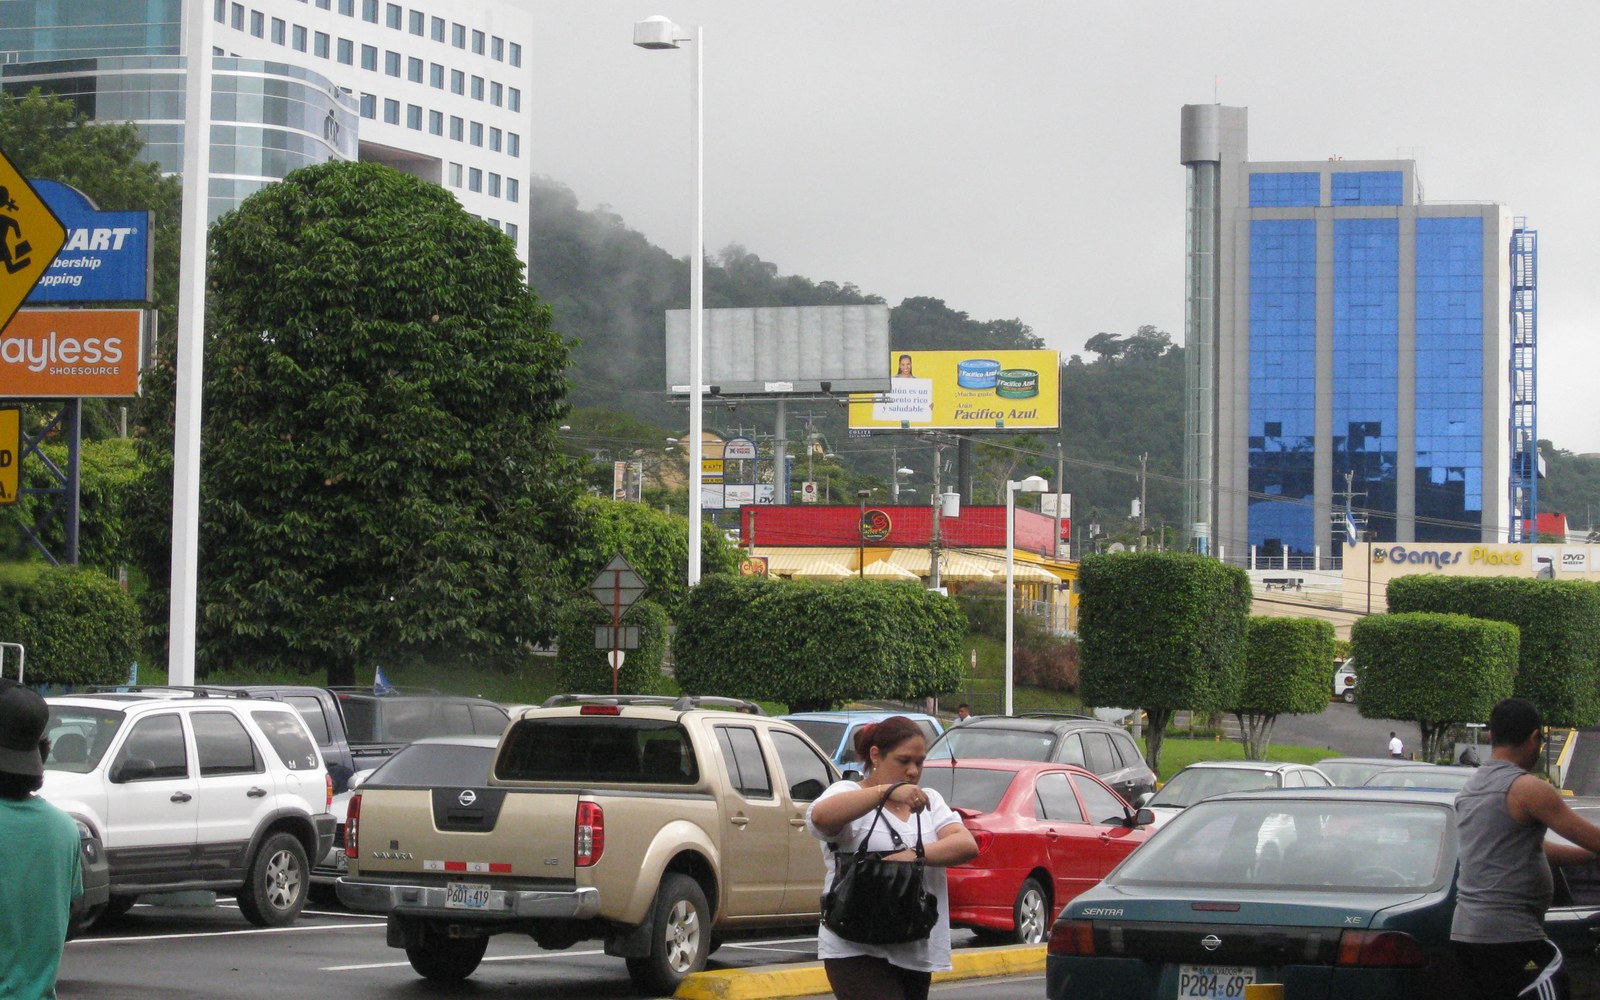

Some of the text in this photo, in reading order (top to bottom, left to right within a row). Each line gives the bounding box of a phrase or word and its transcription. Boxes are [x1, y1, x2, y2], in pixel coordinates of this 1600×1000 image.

[62, 227, 131, 251] ART
[50, 256, 101, 270] bership
[0, 331, 122, 372] ayless
[49, 367, 120, 375] SHOESOURCE
[888, 404, 924, 412] saludable
[1008, 408, 1037, 419] Azul
[759, 496, 775, 504] DV
[1389, 545, 1523, 569] Games Place
[1562, 553, 1585, 561] DVD
[1081, 907, 1124, 917] SENTRA
[1343, 915, 1362, 924] XE
